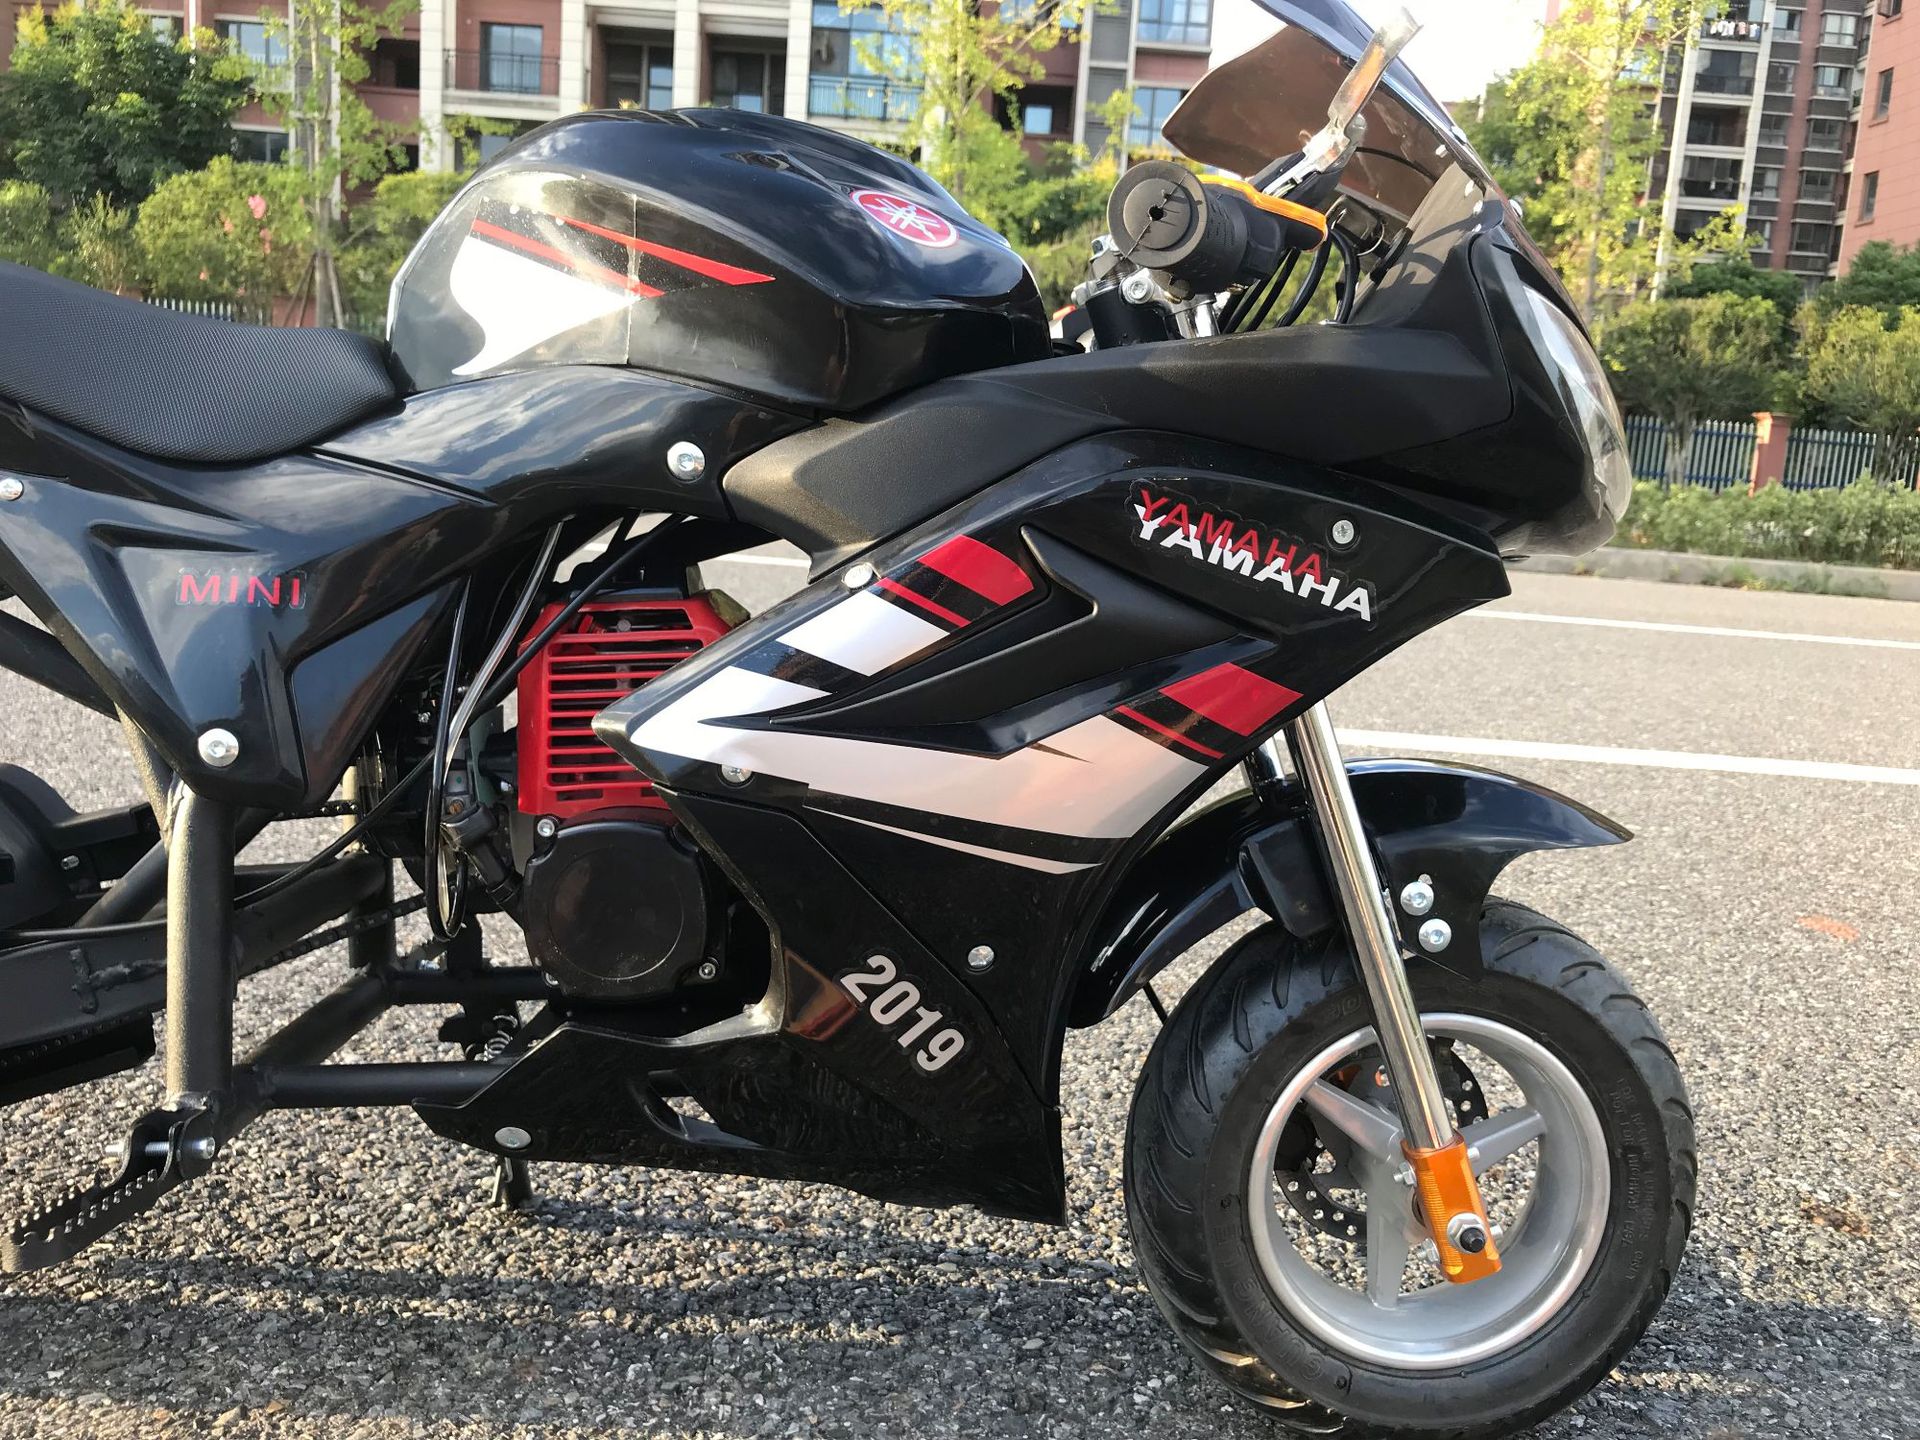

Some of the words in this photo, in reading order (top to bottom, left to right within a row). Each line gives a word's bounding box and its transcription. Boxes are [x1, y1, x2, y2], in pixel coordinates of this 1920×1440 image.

[179, 573, 301, 607] MINI
[1134, 503, 1371, 622] YAMAHA
[1141, 489, 1322, 585] YAMAHA
[840, 954, 965, 1072] 2019
